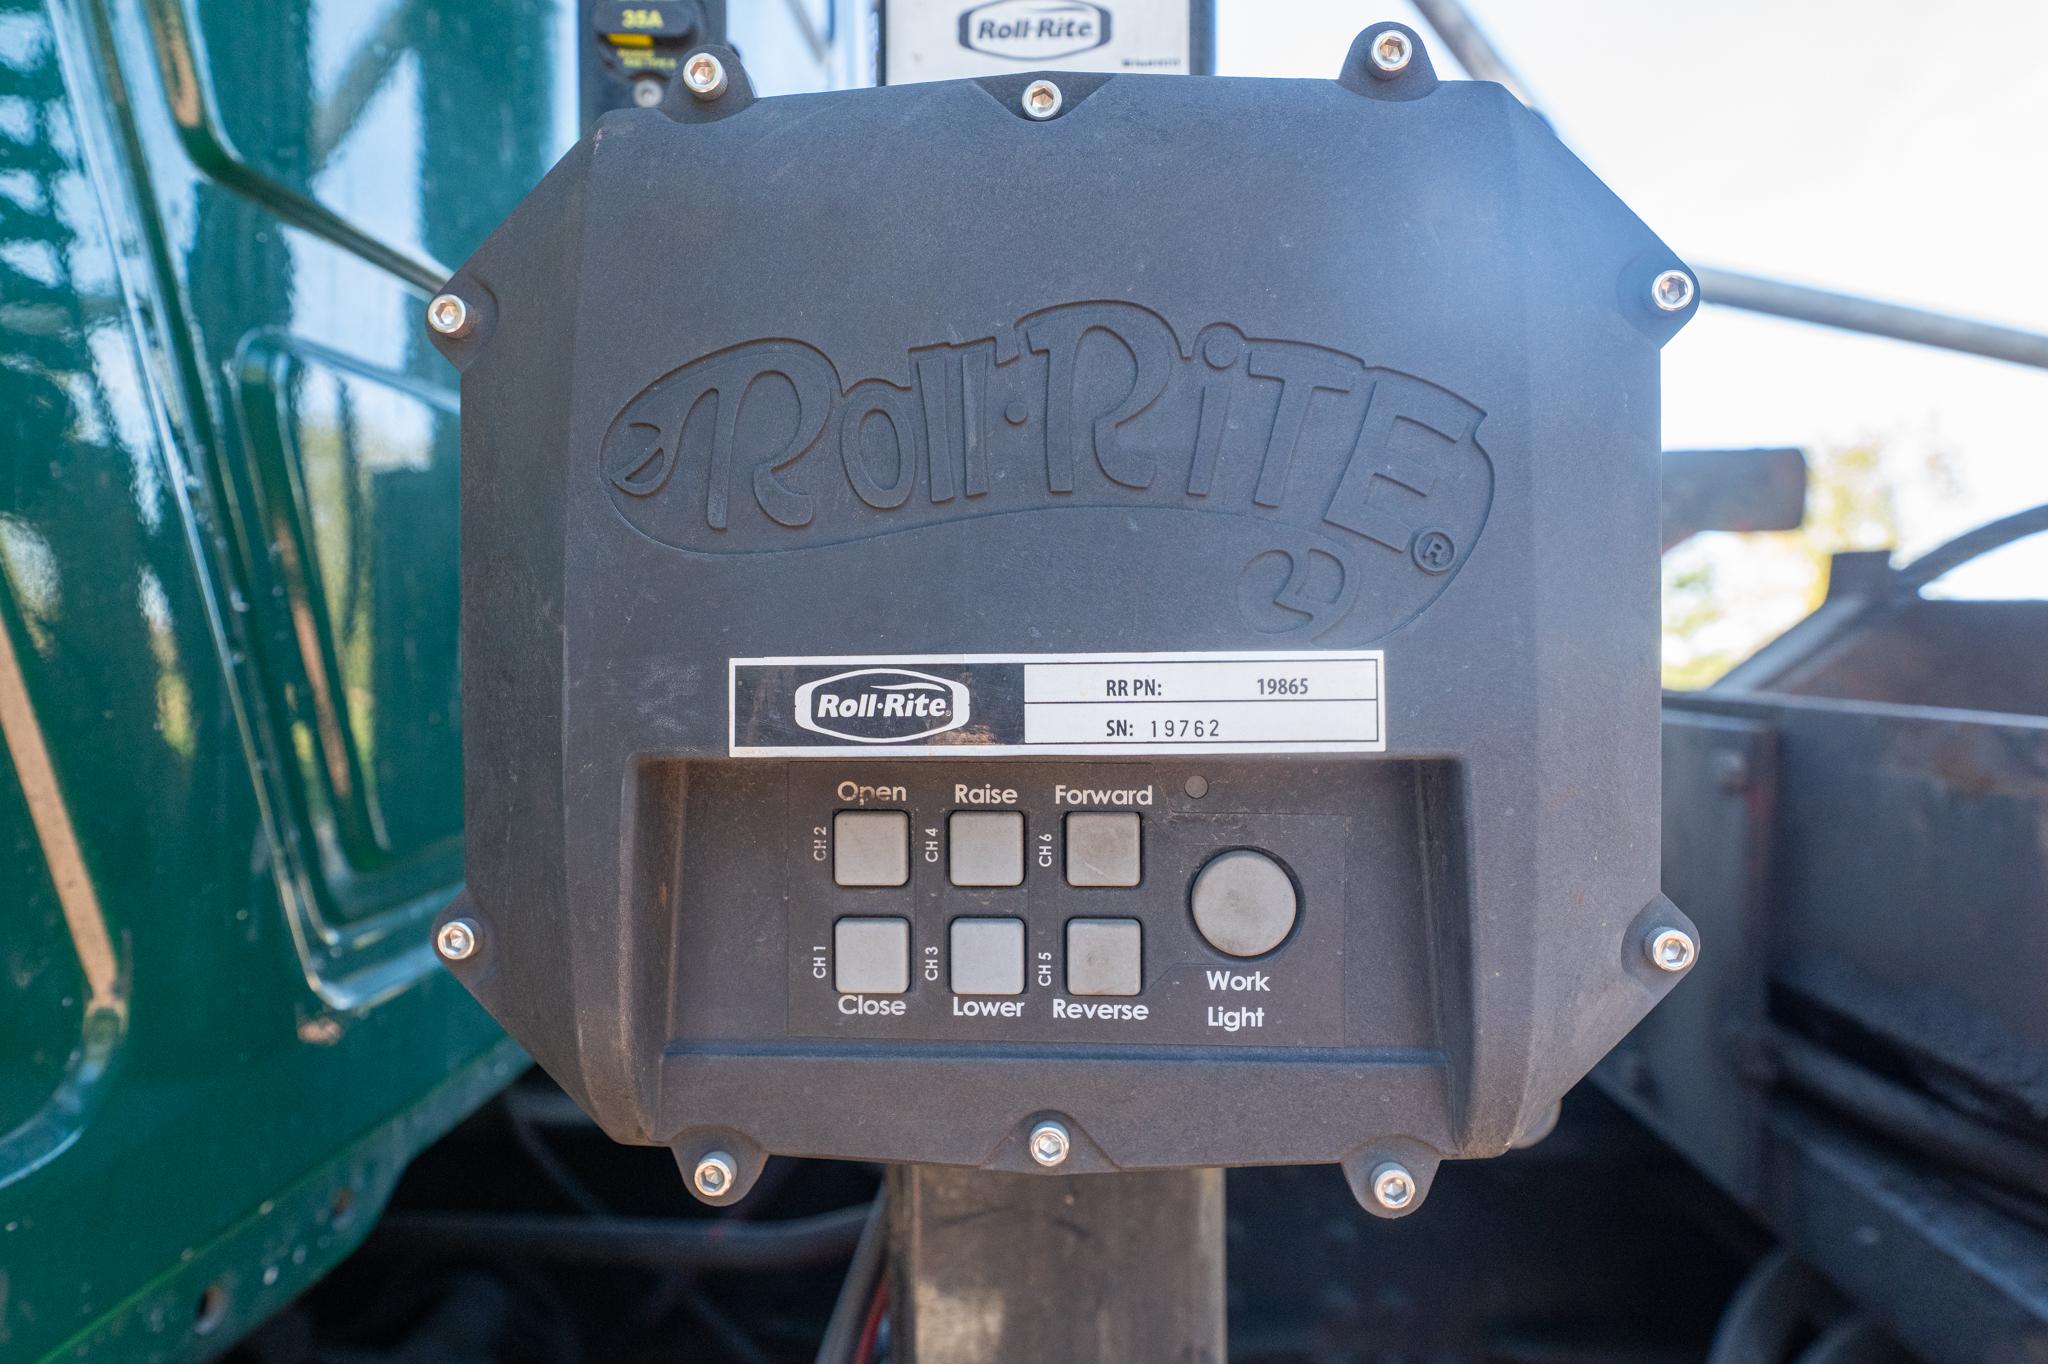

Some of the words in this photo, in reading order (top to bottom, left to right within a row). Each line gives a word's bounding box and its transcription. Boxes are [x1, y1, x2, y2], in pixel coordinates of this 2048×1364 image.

[622, 9, 664, 29] 35A
[1106, 679, 1129, 697] RR
[1133, 679, 1162, 697] PN:
[1257, 677, 1309, 695] 19865
[1106, 719, 1134, 737] SN:
[1151, 719, 1219, 738] 19762
[837, 780, 907, 806] Open
[954, 783, 1018, 804] Raise
[1055, 784, 1153, 806] Forward
[813, 826, 827, 836] 2
[924, 827, 939, 837] 4
[1038, 833, 1053, 842] 6
[813, 839, 827, 862] CH
[924, 840, 939, 863] CH
[1038, 845, 1053, 868] CH
[924, 946, 939, 956] 3
[1037, 952, 1052, 961] 5
[812, 956, 827, 979] CH
[924, 958, 939, 981] CH
[1037, 964, 1052, 987] CH
[1206, 970, 1271, 992] Work
[837, 994, 907, 1016] Close
[952, 996, 1025, 1018] Lower
[1052, 998, 1150, 1021] Reverse
[1207, 1006, 1265, 1032] Light
